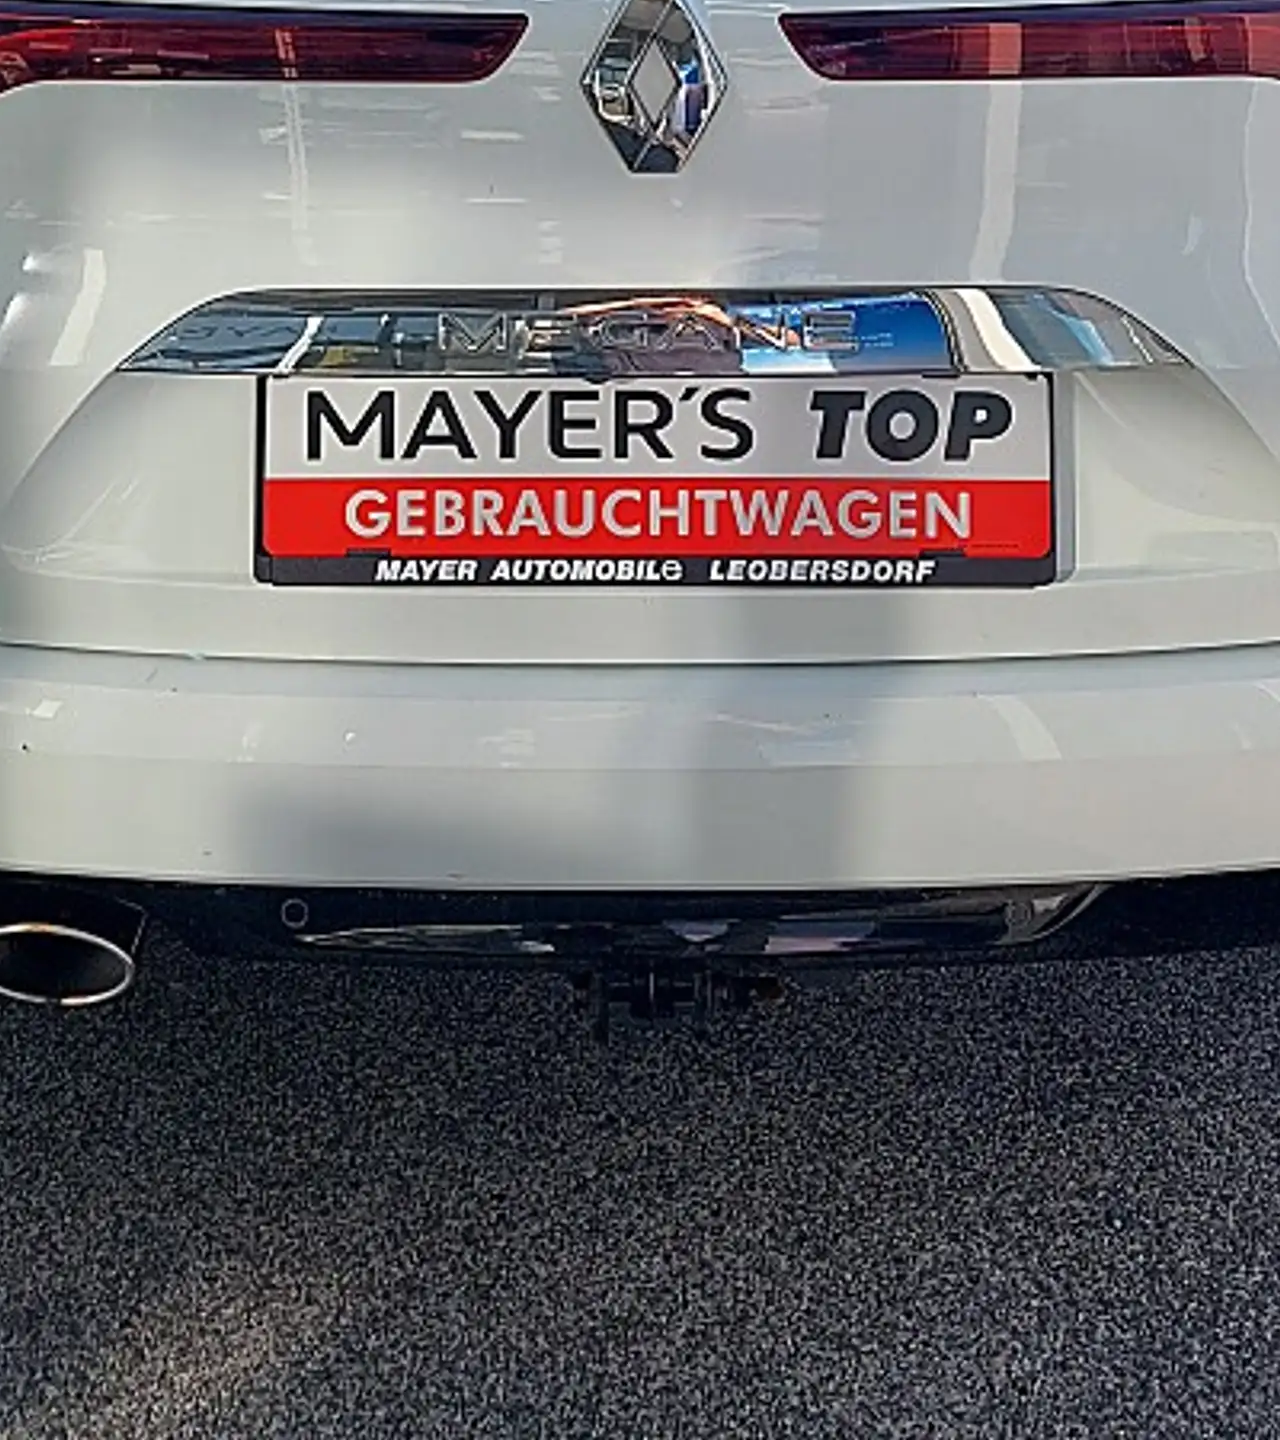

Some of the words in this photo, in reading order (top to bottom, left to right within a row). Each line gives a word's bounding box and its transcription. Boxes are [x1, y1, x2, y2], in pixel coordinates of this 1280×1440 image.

[438, 312, 859, 352] MEGANE
[810, 389, 1013, 461] TOP
[345, 489, 971, 539] GEBRAUCHTWAGEN
[374, 560, 478, 581] MAYER
[709, 560, 936, 582] LEOBERSDORF
